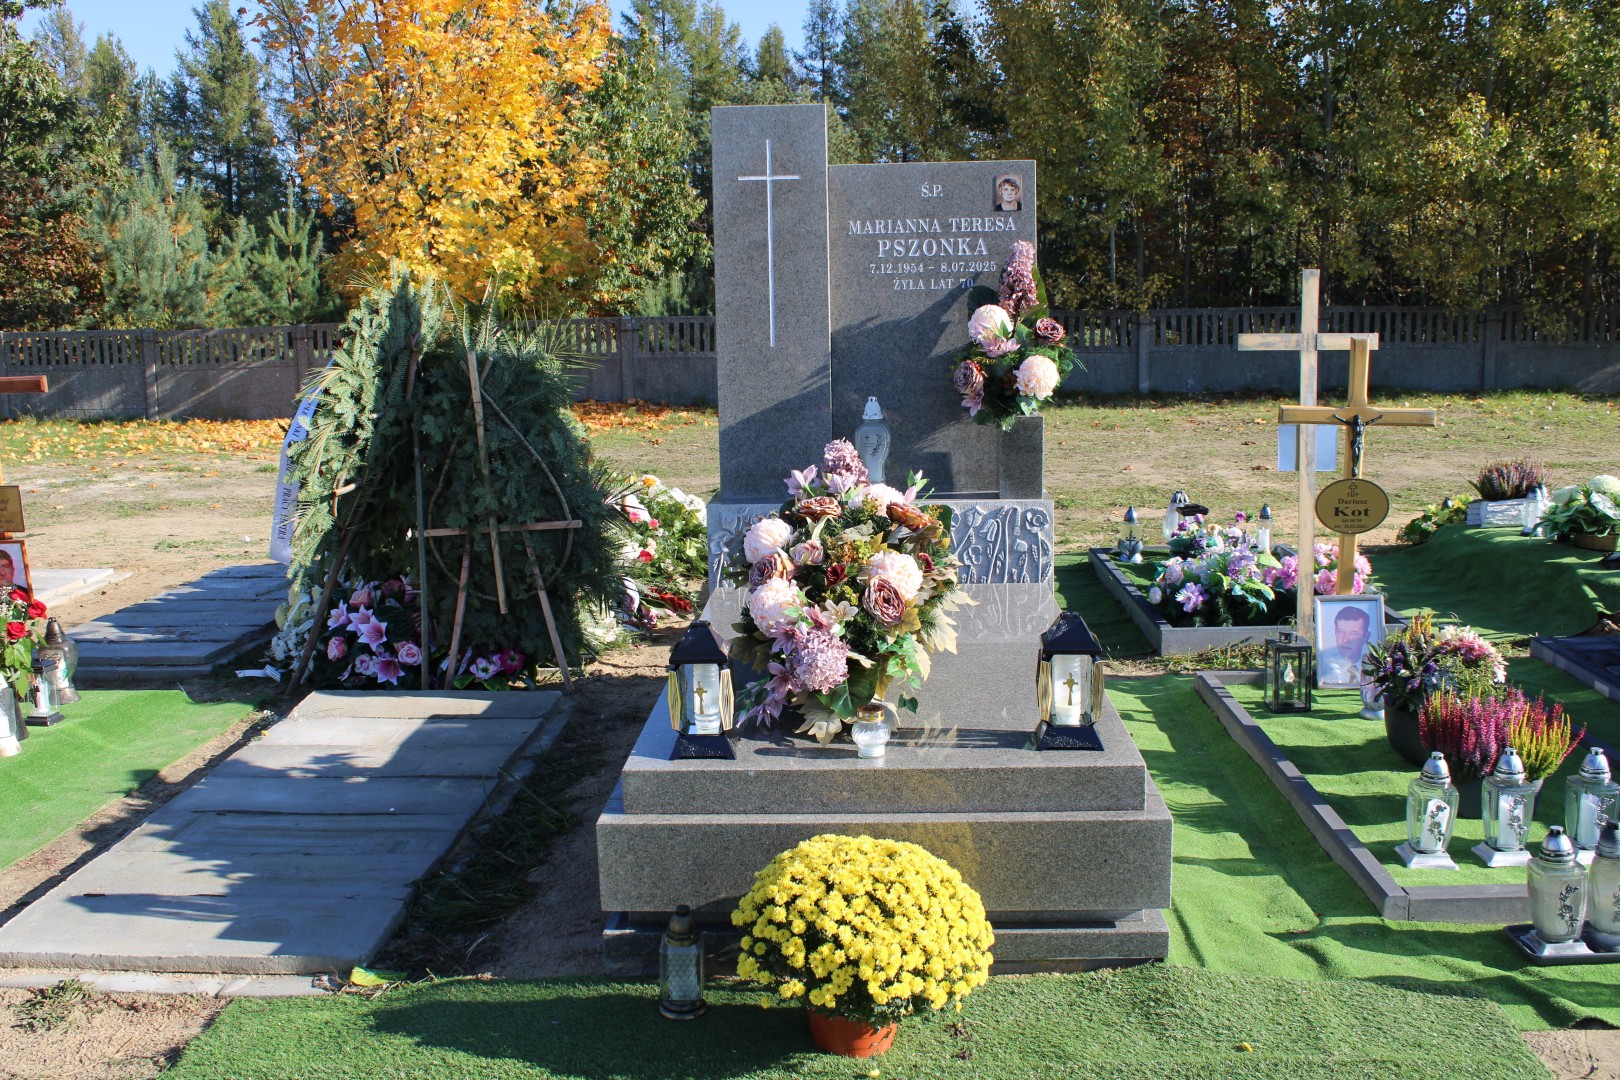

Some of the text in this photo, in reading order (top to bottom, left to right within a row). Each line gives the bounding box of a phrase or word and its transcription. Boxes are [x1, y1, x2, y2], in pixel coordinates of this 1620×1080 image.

[848, 216, 1017, 235] MARIANNA TERESA
[877, 237, 990, 258] PSZONKA
[869, 262, 924, 275] 7.12.1954
[940, 261, 997, 273] 8.07.2025
[893, 277, 974, 291] ŻYŁA LAT 70
[1333, 506, 1371, 517] Kot
